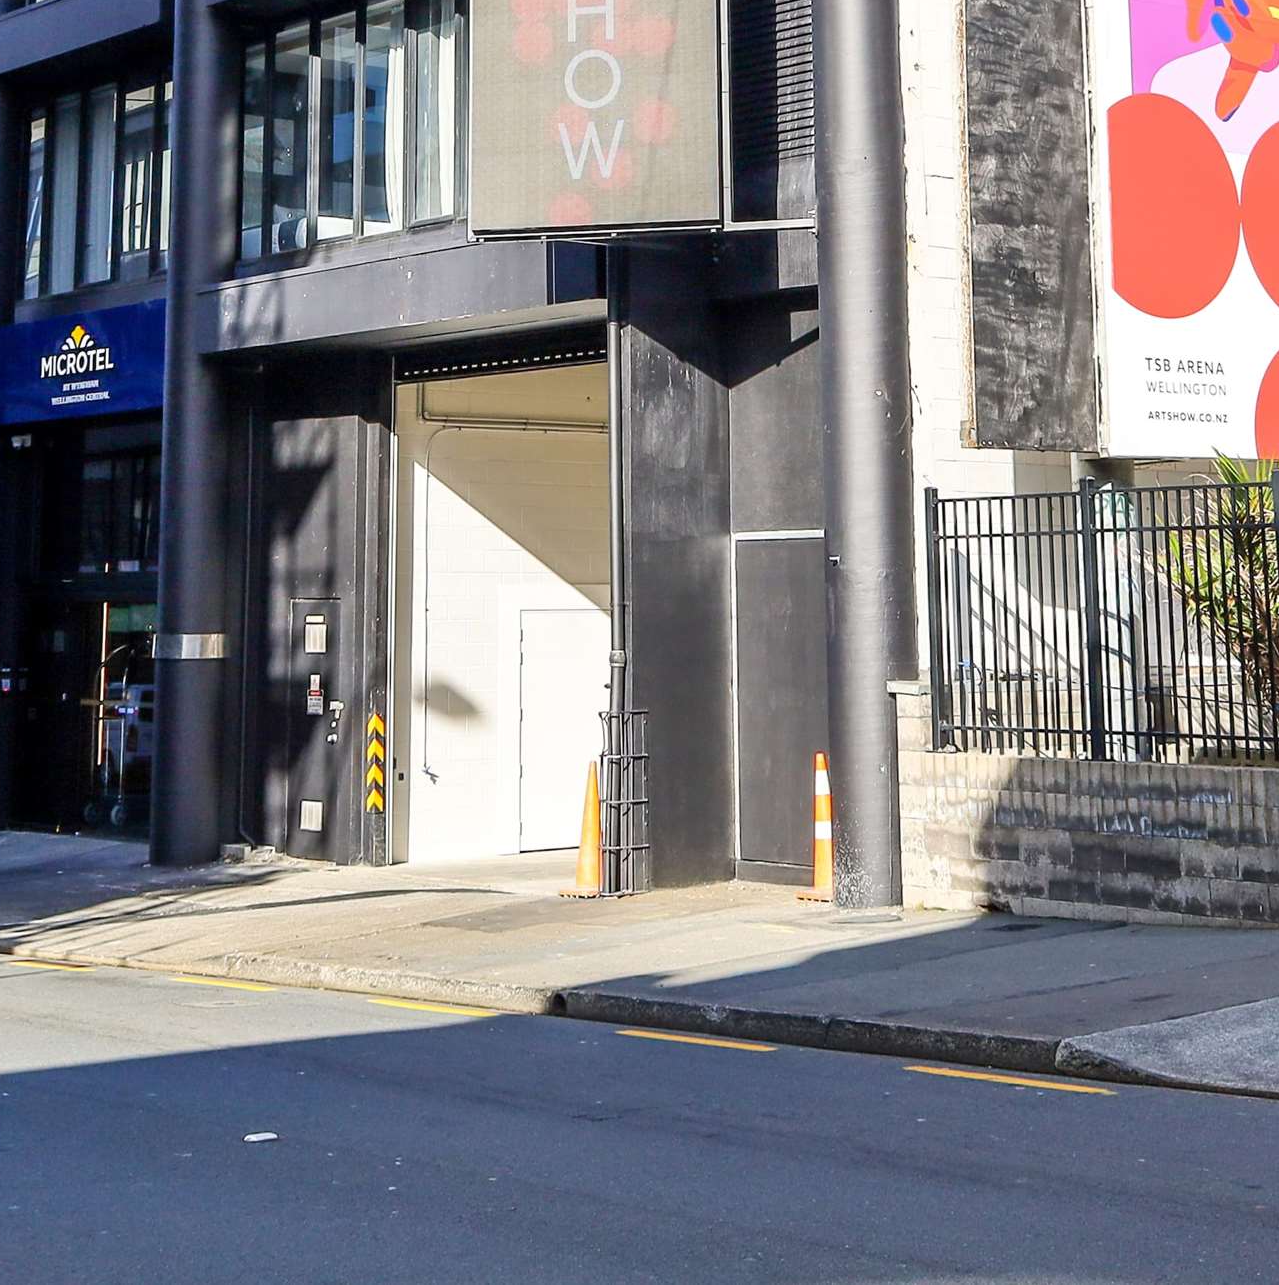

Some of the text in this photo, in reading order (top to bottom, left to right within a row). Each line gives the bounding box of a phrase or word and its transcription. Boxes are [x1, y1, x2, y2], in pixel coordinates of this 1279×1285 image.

[40, 347, 114, 379] MICROTEL
[1144, 357, 1224, 375] TSB ARENA
[1145, 380, 1227, 396] WELLINGTON
[1148, 411, 1228, 423] ARTSHOW.CO.NZ
